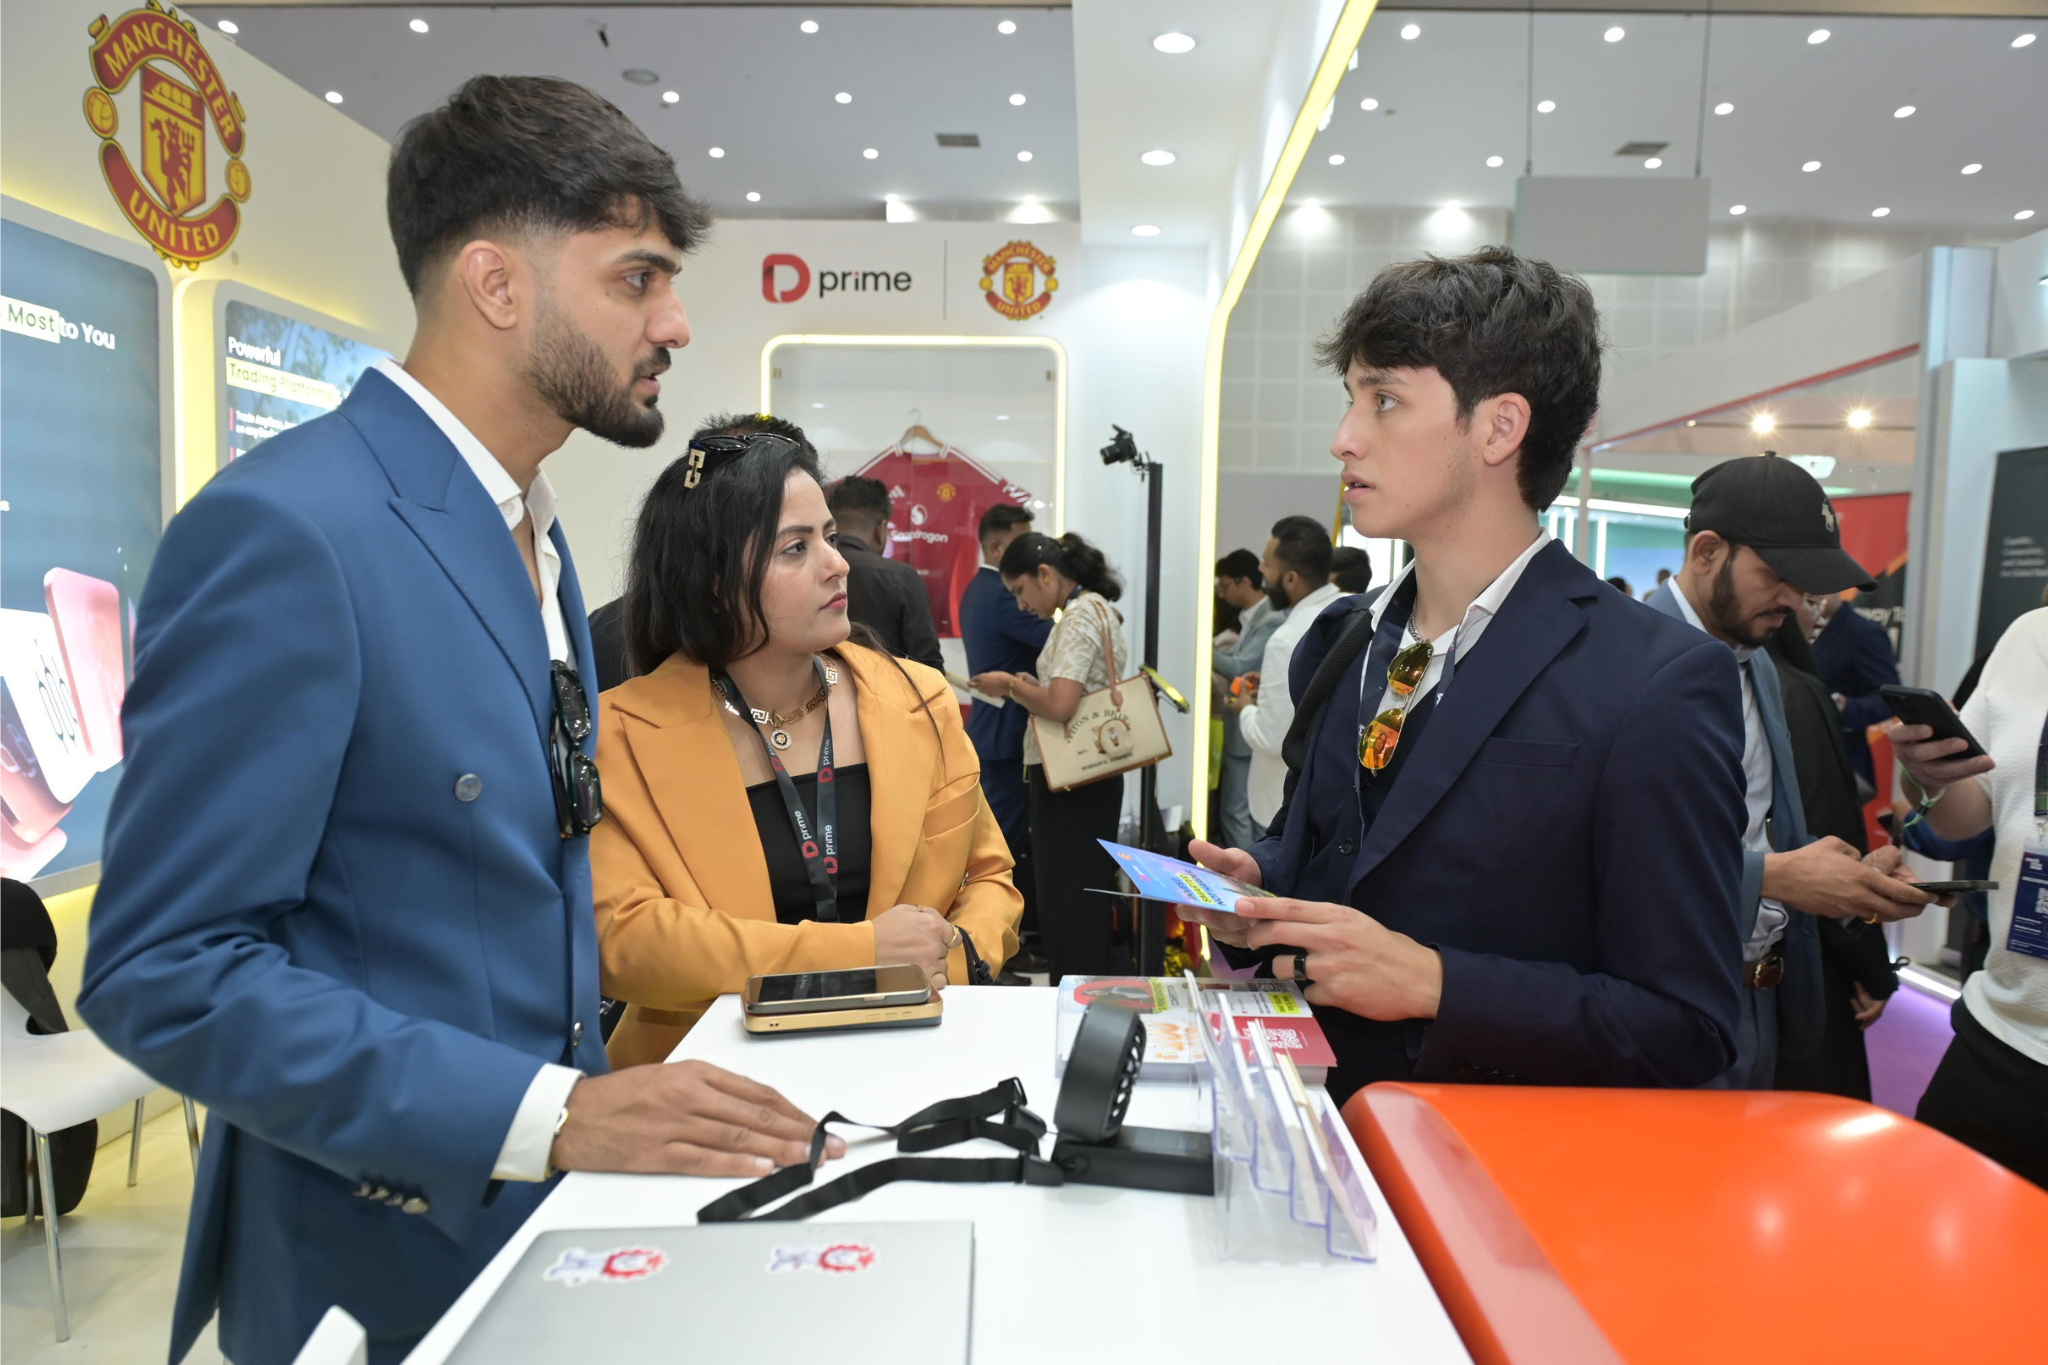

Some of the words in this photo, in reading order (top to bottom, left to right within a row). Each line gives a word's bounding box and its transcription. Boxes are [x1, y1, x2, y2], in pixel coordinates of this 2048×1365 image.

[103, 21, 235, 139] MANCHESTER
[129, 189, 220, 252] UNITED
[987, 245, 1051, 272] MANCHESTER
[818, 270, 912, 299] prime
[995, 300, 1042, 317] UNITED
[8, 303, 55, 333] Most
[60, 316, 79, 340] to
[81, 322, 116, 350] You
[228, 336, 282, 367] Powerful
[229, 363, 277, 393] Trading
[794, 810, 812, 840] prime
[824, 824, 836, 855] prime
